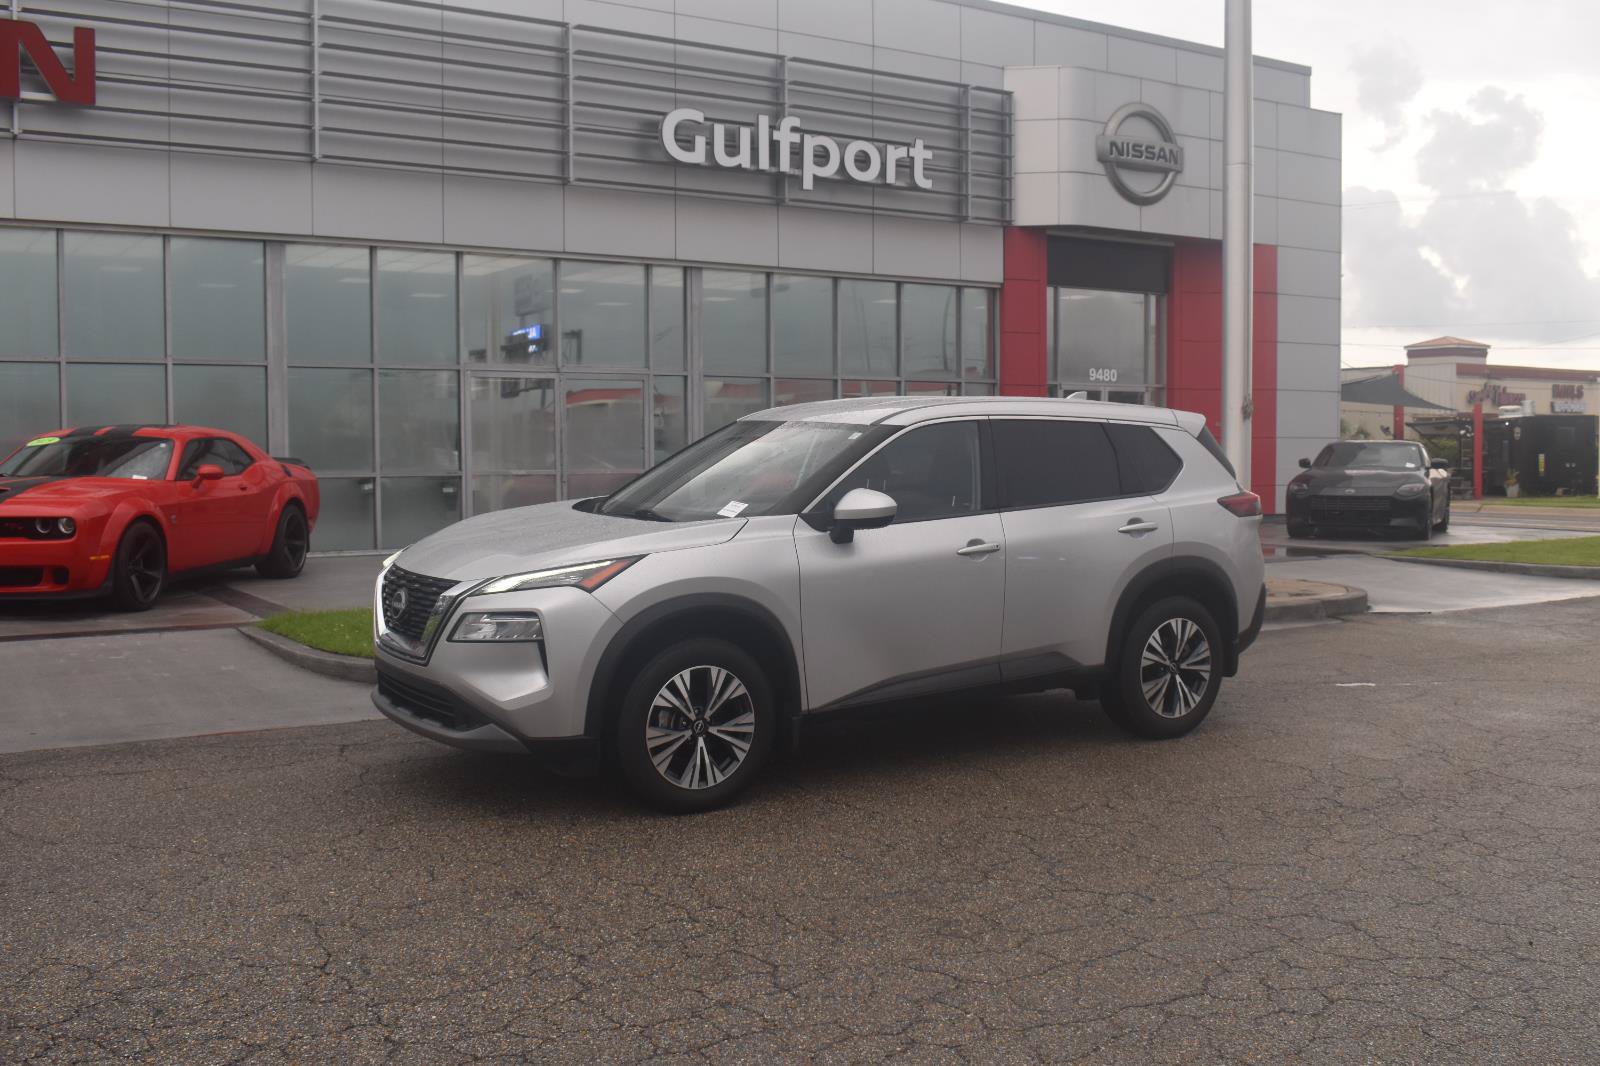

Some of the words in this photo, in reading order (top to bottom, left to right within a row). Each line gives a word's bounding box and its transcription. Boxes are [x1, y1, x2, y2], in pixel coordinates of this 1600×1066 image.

[661, 107, 933, 191] Gulfport
[1109, 140, 1179, 165] NISSAN
[1089, 367, 1118, 382] 9480
